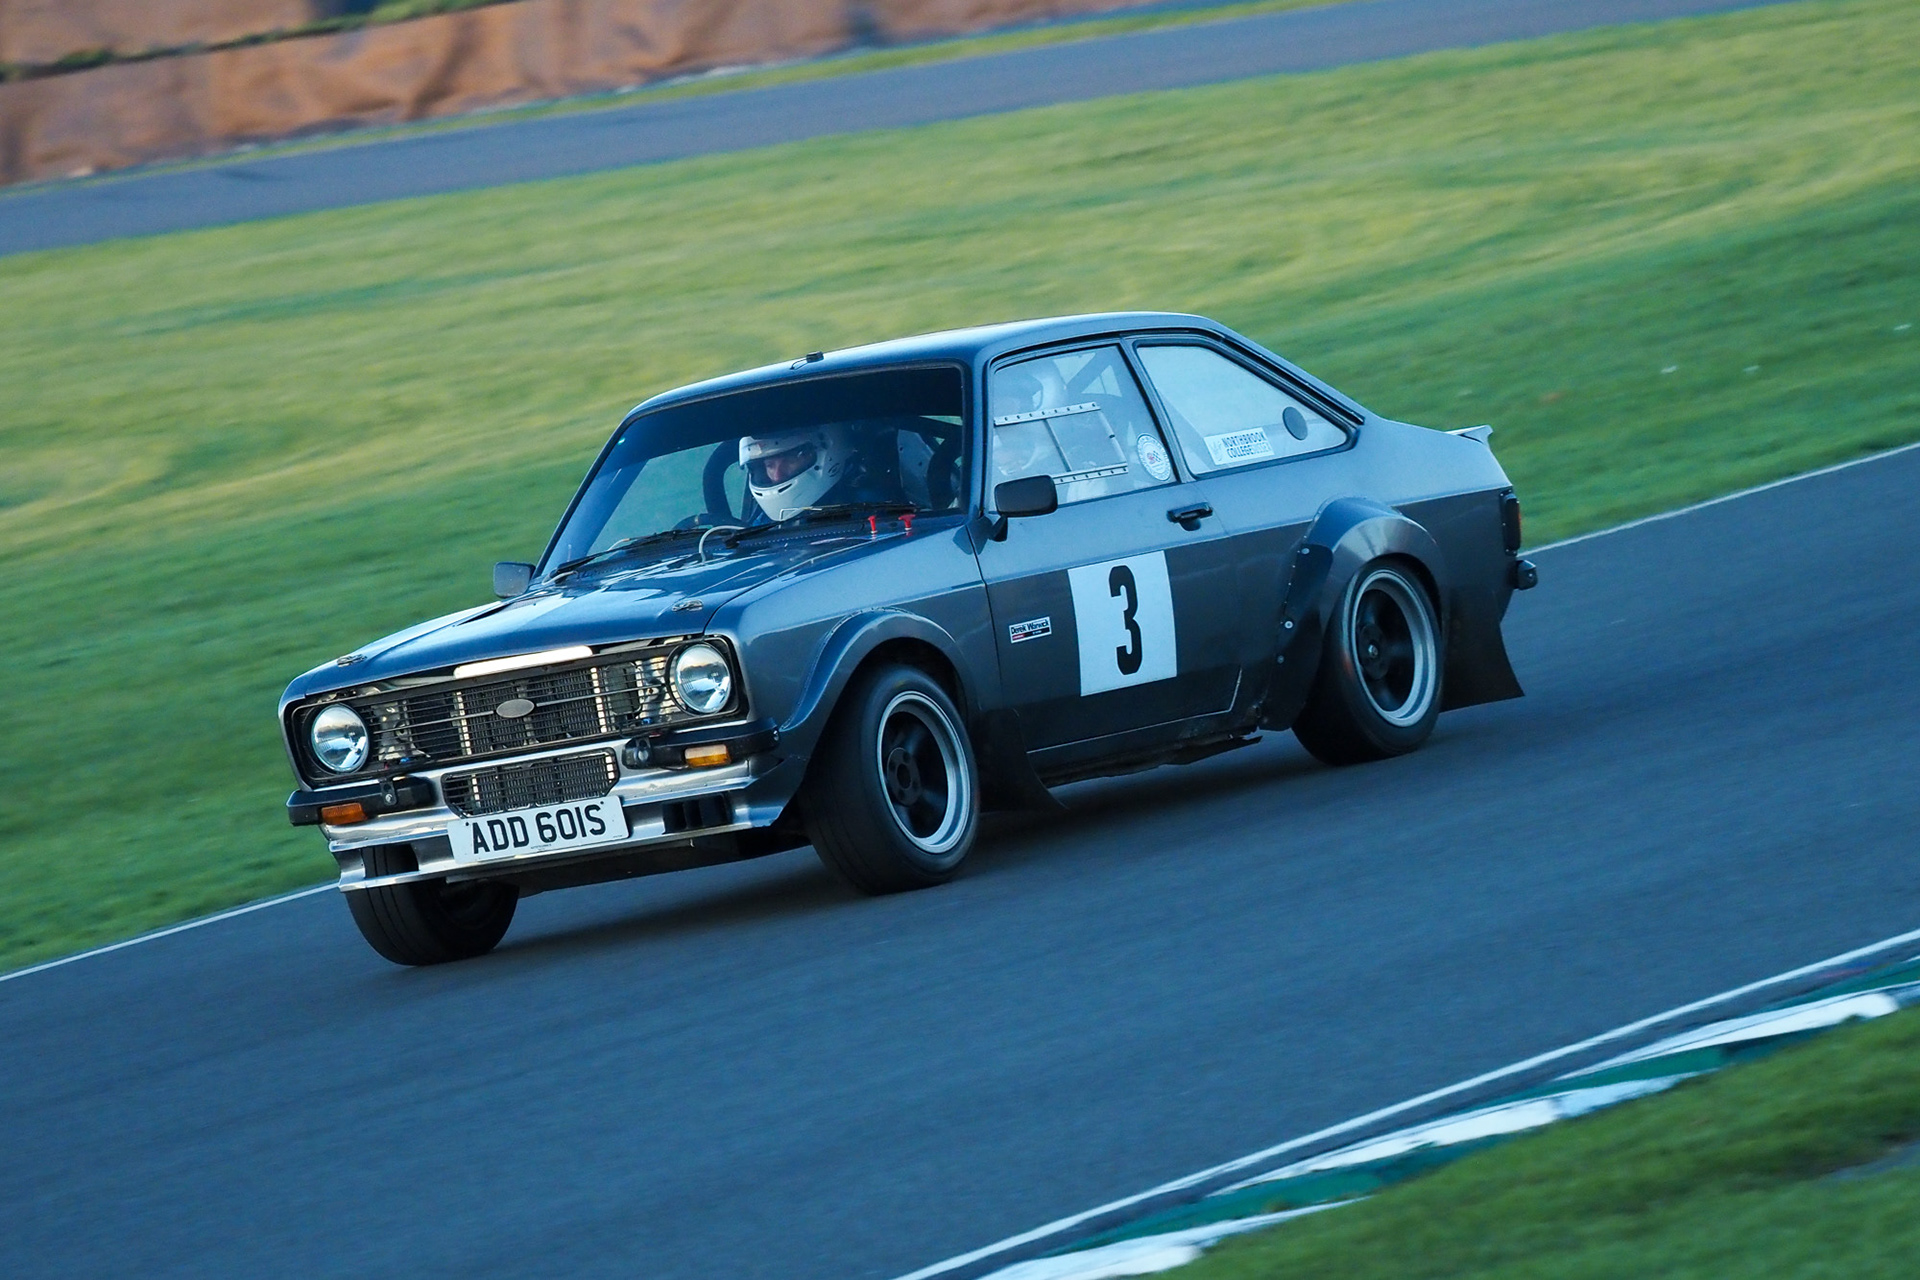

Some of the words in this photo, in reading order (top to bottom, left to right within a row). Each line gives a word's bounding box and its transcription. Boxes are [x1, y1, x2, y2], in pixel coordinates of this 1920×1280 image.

[1222, 431, 1267, 447] NORTHBROOK
[1227, 445, 1253, 458] COLLEGE
[1011, 624, 1027, 635] Derek
[1027, 619, 1049, 631] Warwick
[1108, 564, 1143, 675] 3
[473, 816, 530, 854] ADD
[535, 804, 606, 843] 601S
